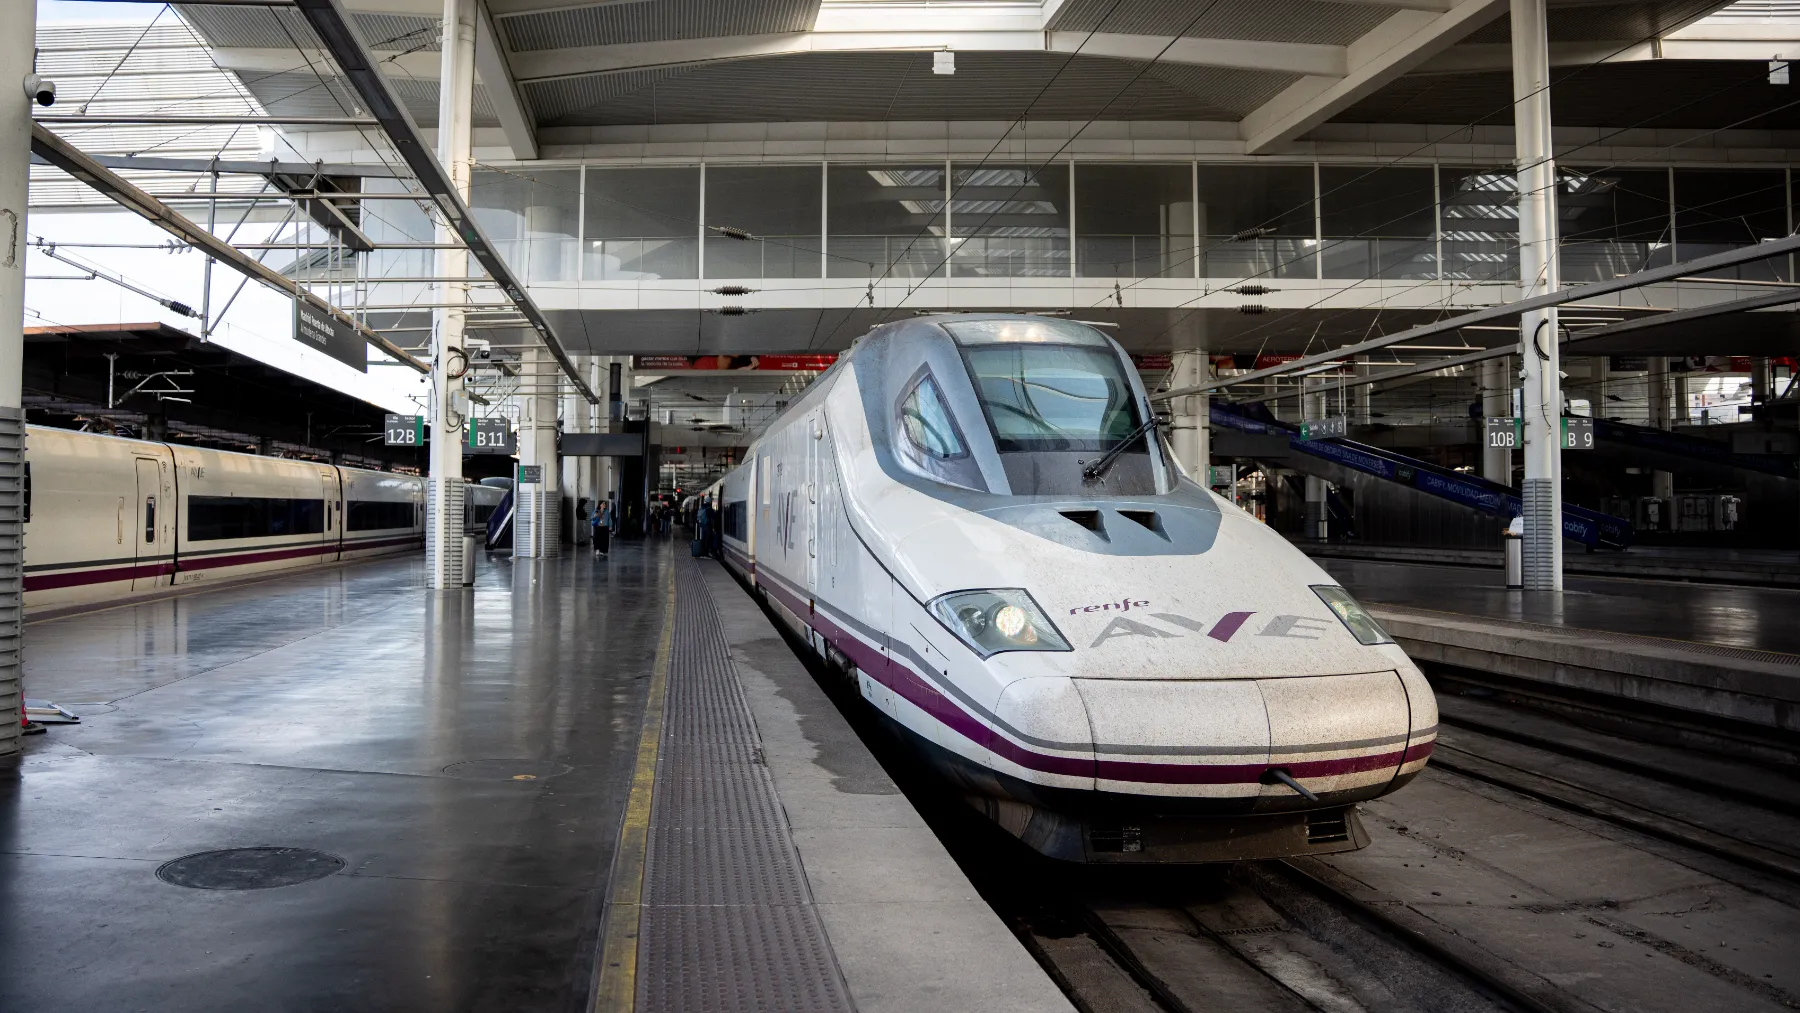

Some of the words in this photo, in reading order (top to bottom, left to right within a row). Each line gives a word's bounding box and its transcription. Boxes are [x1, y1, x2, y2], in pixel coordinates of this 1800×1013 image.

[1563, 520, 1588, 538] cabify
[1601, 523, 1620, 538] cabify
[1069, 597, 1150, 616] renfe
